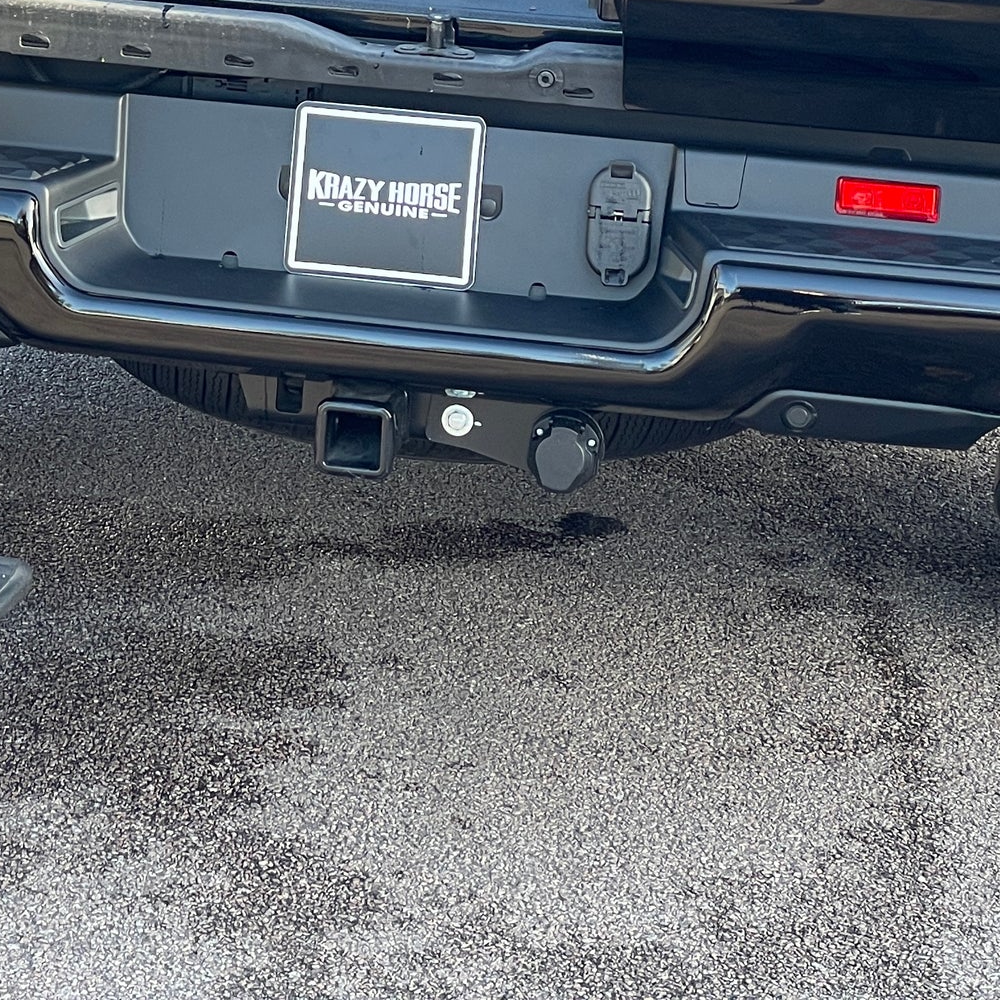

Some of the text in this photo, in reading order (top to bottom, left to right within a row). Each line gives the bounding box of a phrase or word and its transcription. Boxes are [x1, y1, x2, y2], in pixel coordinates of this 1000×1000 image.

[307, 168, 463, 215] KRAZY HORSE
[337, 200, 430, 220] GENUINE
